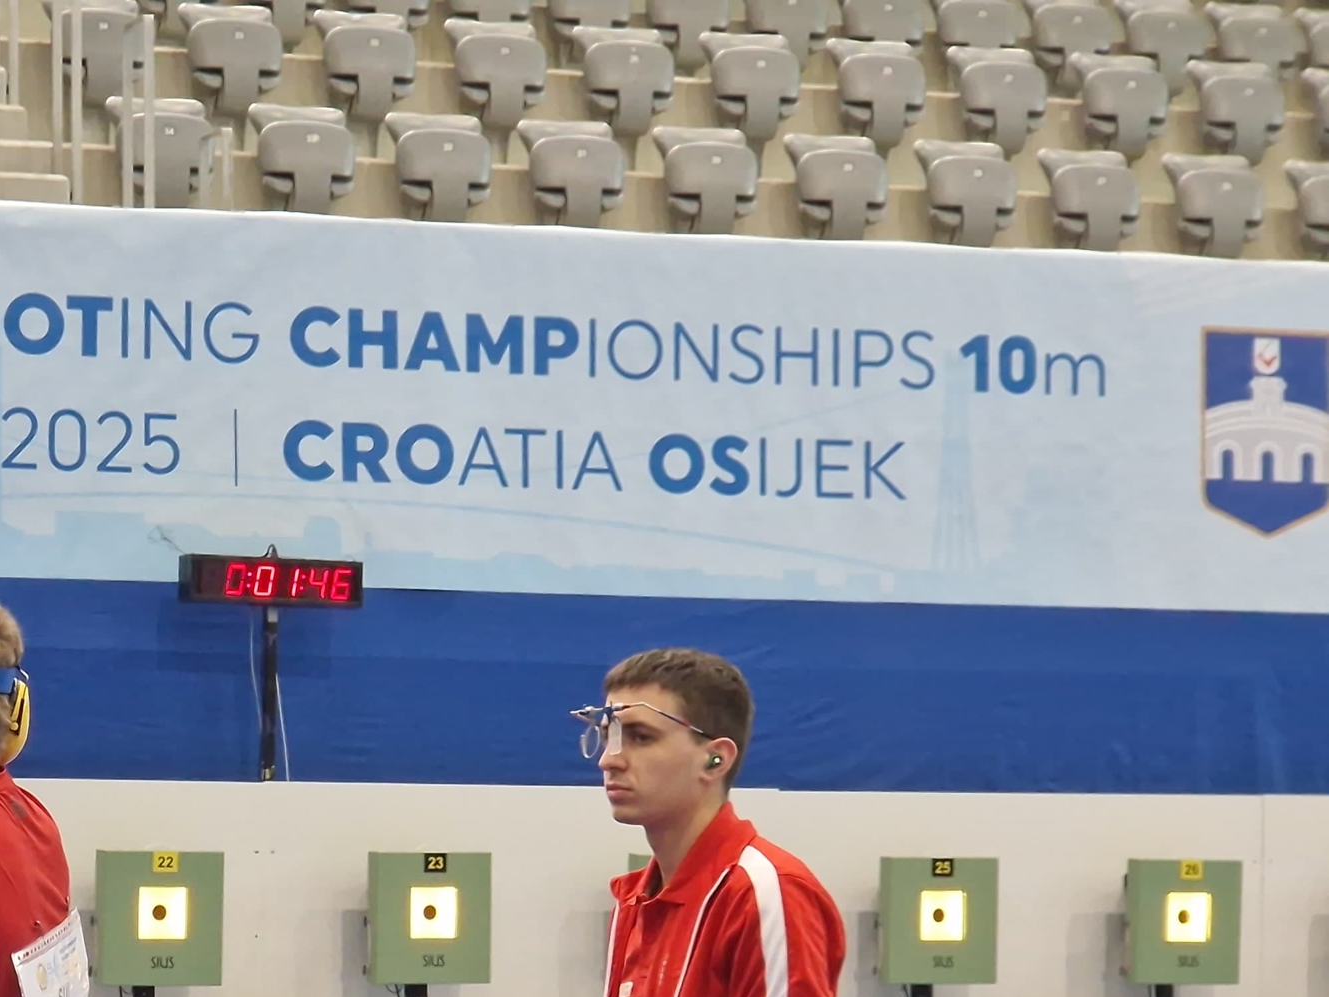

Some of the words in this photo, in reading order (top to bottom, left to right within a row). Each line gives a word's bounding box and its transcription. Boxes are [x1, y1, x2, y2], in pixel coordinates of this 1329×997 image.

[289, 305, 936, 391] CHAMPIONSHIPS
[958, 333, 1106, 397] 10m
[1, 406, 181, 475] 2025
[282, 419, 622, 492] CROATIA
[648, 432, 907, 501] OSIJEK
[224, 562, 351, 601] 0:01:46
[157, 855, 175, 869] 22
[427, 855, 444, 870] 23
[934, 861, 951, 874] 25
[150, 955, 175, 970] SIUS
[422, 953, 445, 968] SIUS
